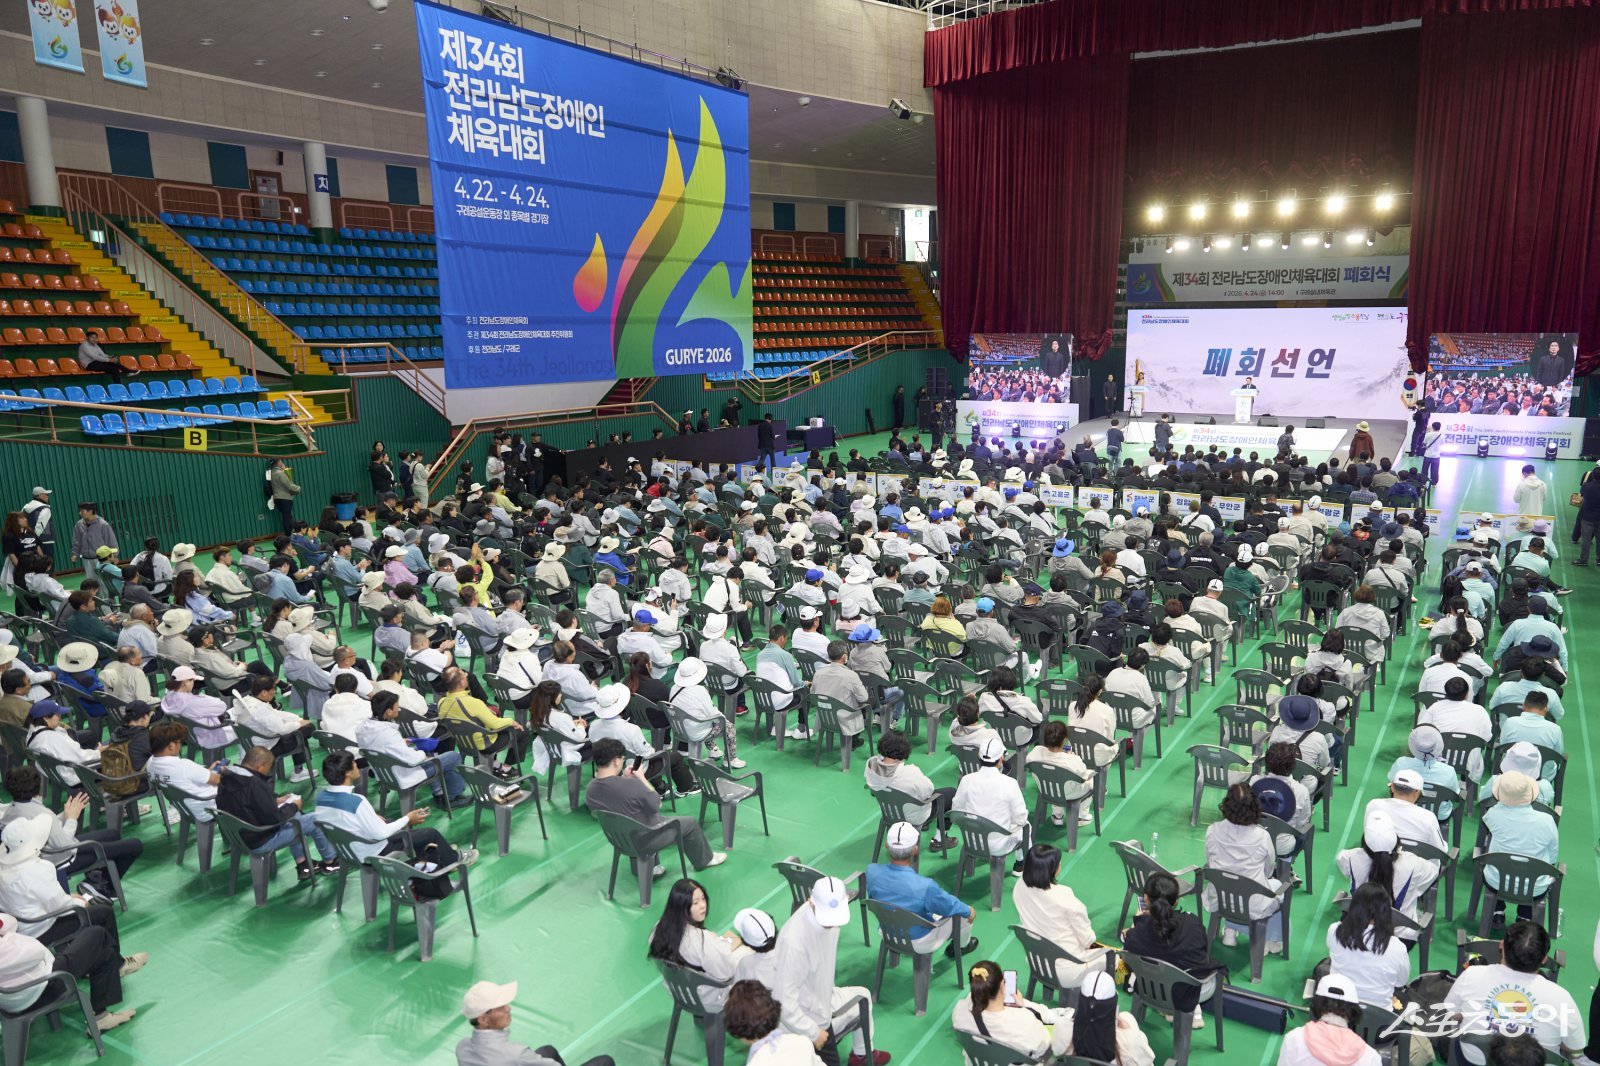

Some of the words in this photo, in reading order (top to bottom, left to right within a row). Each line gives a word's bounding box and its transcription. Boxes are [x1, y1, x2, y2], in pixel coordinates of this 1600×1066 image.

[438, 28, 524, 84] 제34회
[443, 70, 606, 138] 전라남도장애인
[447, 112, 546, 164] 체육대회
[1172, 272, 1210, 287] 제34회
[1212, 268, 1340, 286] 전라남도장애인체육대회
[1344, 266, 1391, 282] 폐회식
[666, 349, 704, 365] GURYE
[706, 348, 732, 363] 2026
[190, 431, 202, 445] B
[1484, 983, 1510, 1010] HOLIDAY
